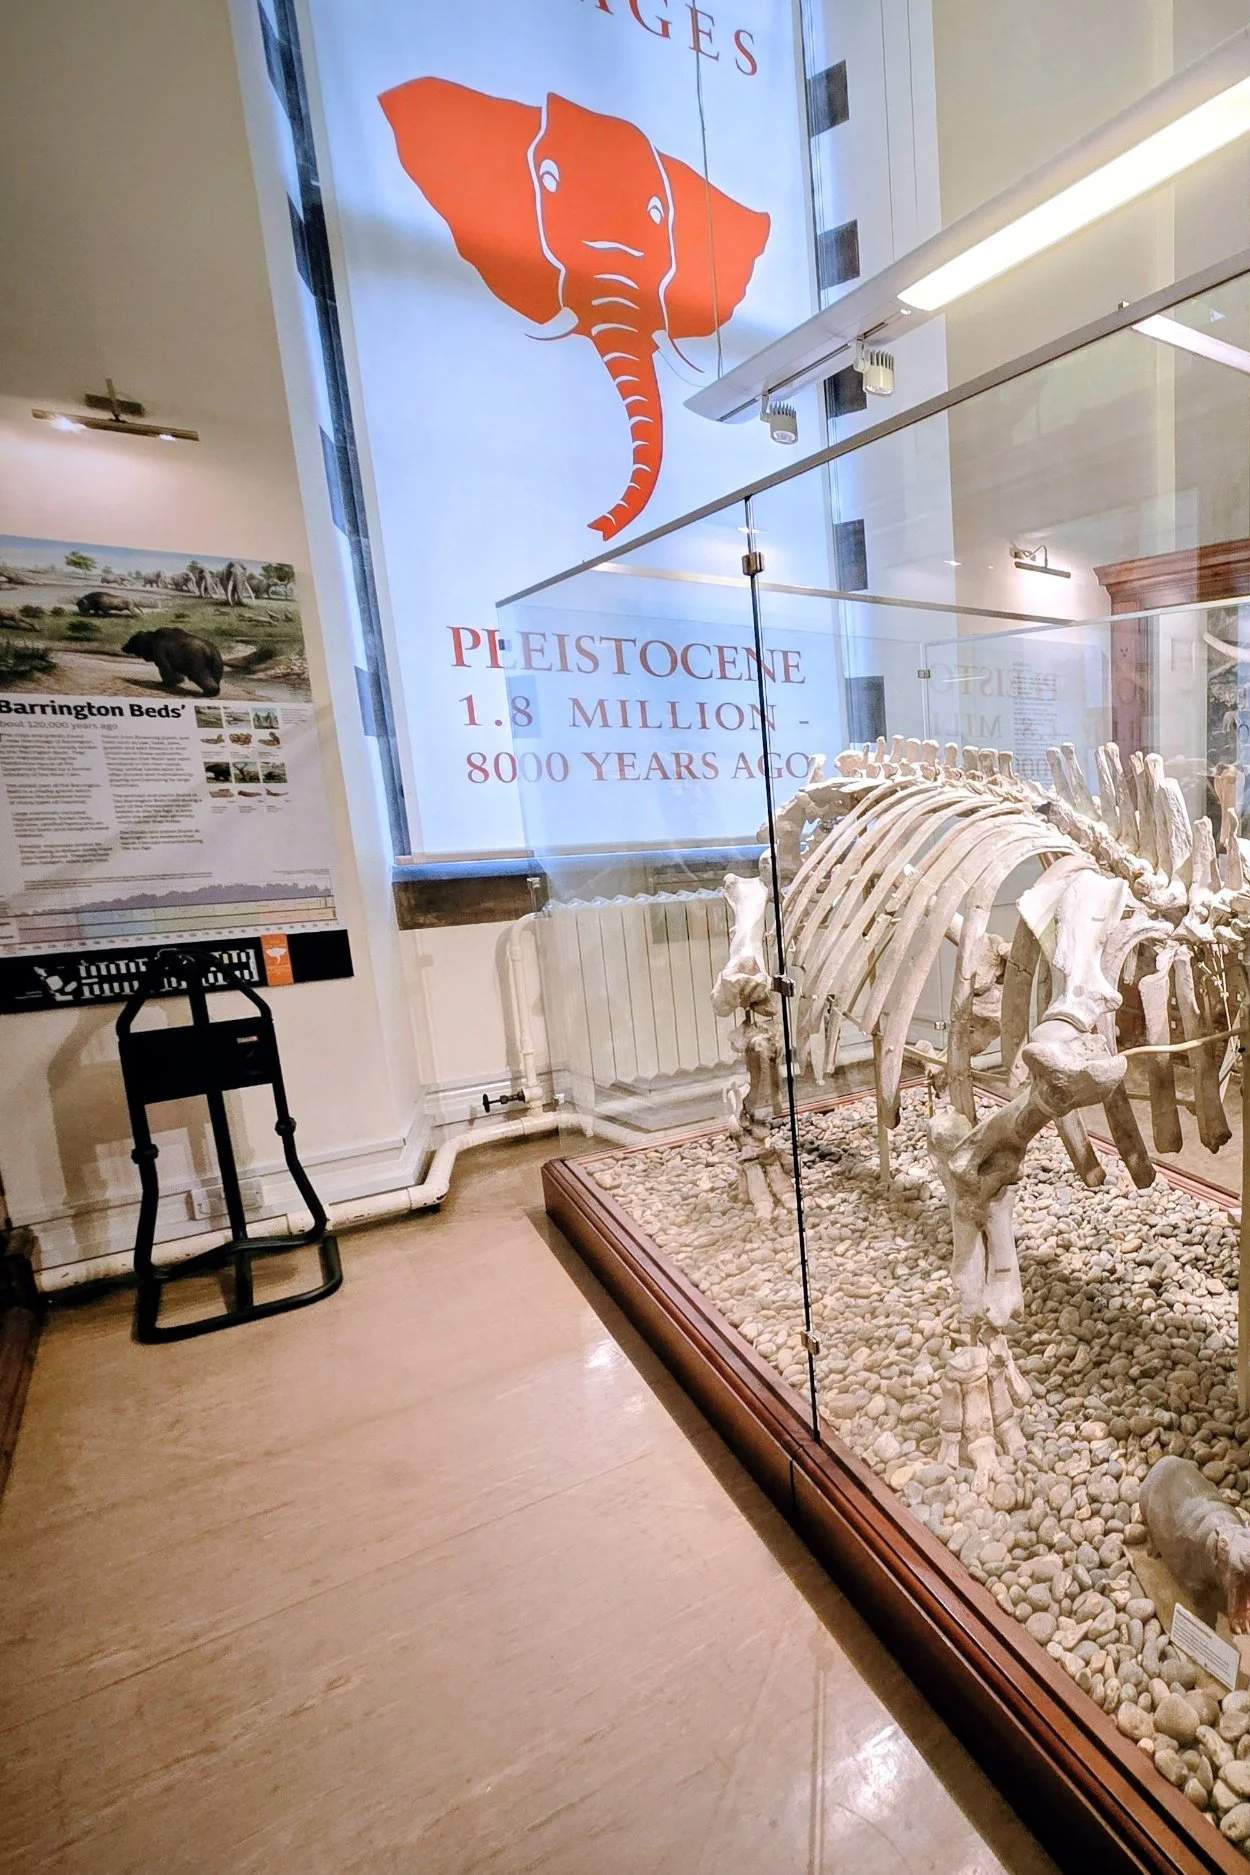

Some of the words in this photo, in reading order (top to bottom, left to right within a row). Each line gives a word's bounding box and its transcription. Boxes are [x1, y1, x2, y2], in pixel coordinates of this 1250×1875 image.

[576, 0, 757, 76] GES
[446, 625, 806, 684] PLEISTOCENE
[0, 700, 124, 720] Barrington
[458, 694, 534, 727] 1.8
[567, 697, 777, 733] MILLION
[466, 751, 569, 784] 8000
[582, 751, 720, 782] YEARS
[731, 751, 810, 779] AGO
